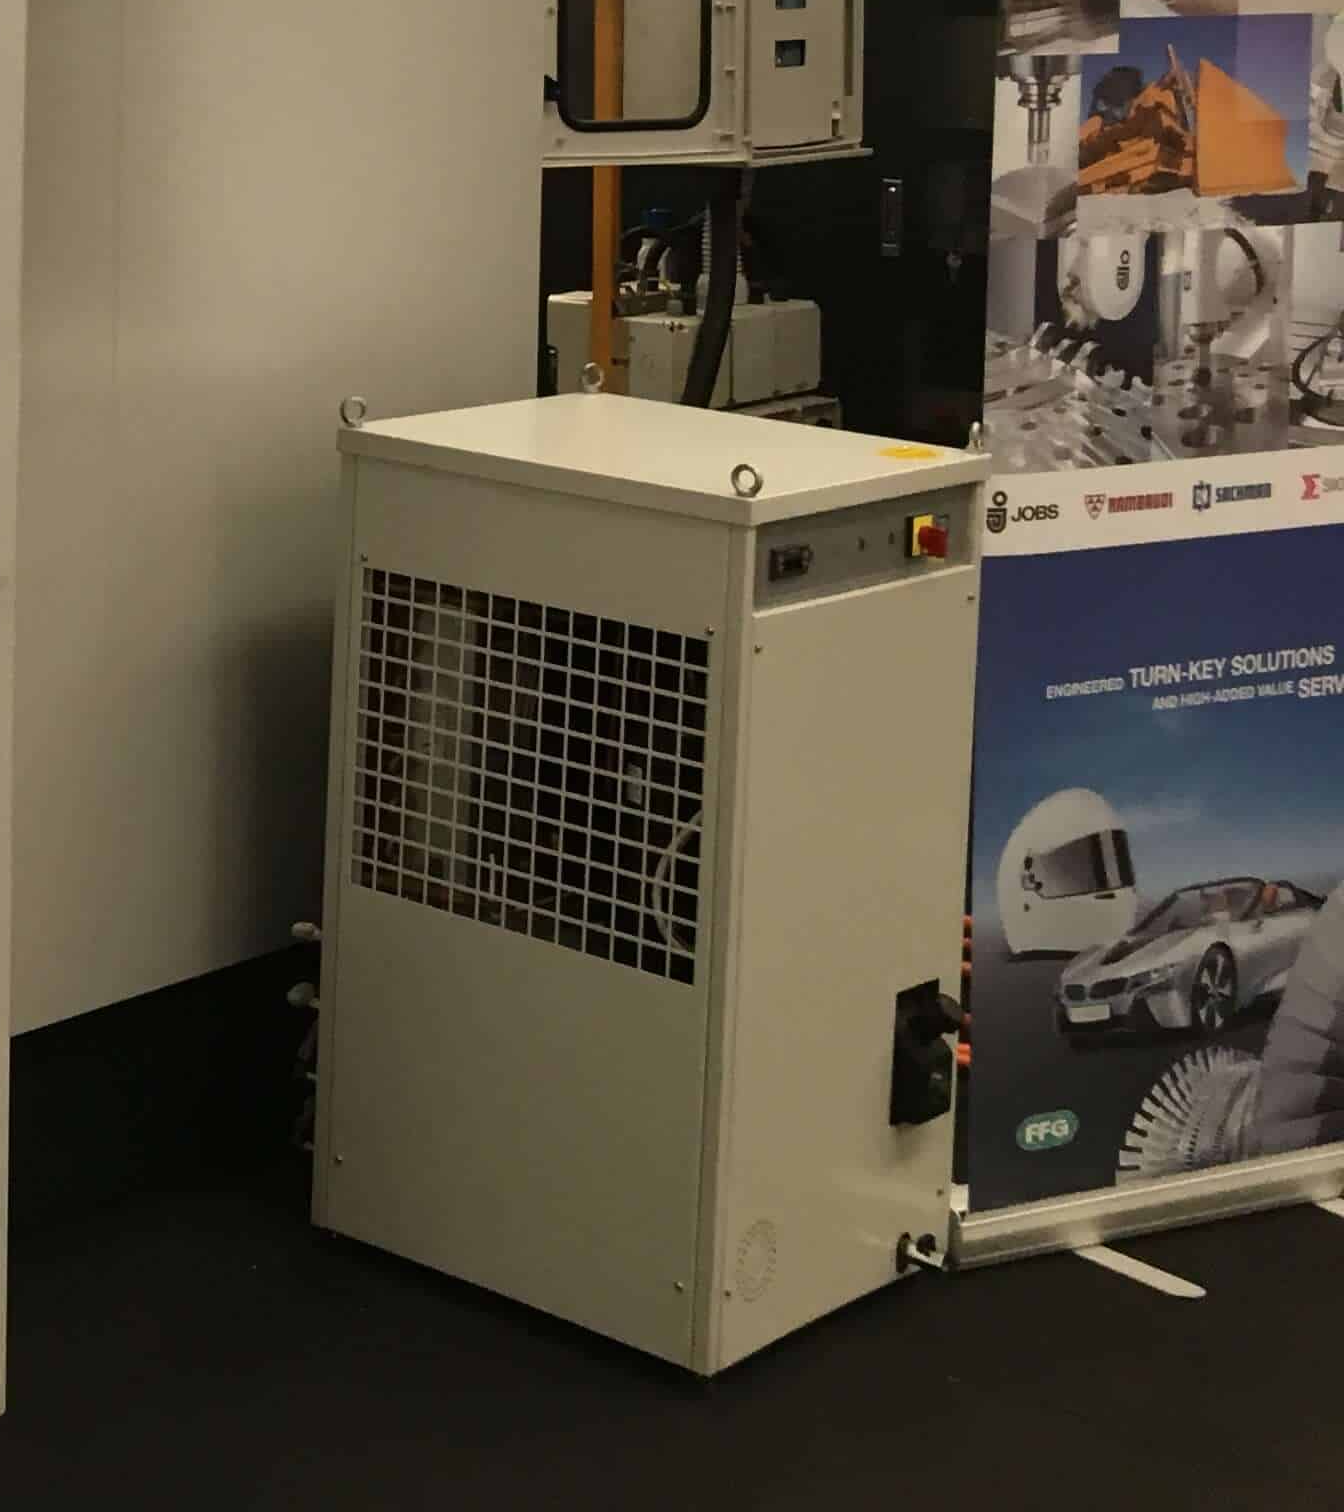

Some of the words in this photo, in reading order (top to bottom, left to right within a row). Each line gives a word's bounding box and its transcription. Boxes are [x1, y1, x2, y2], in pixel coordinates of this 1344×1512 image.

[1011, 503, 1059, 522] JOBS
[1045, 677, 1125, 700] ENGINEERED
[1129, 657, 1227, 688] TURN-KEY
[1230, 644, 1336, 677] SOLUTIONS
